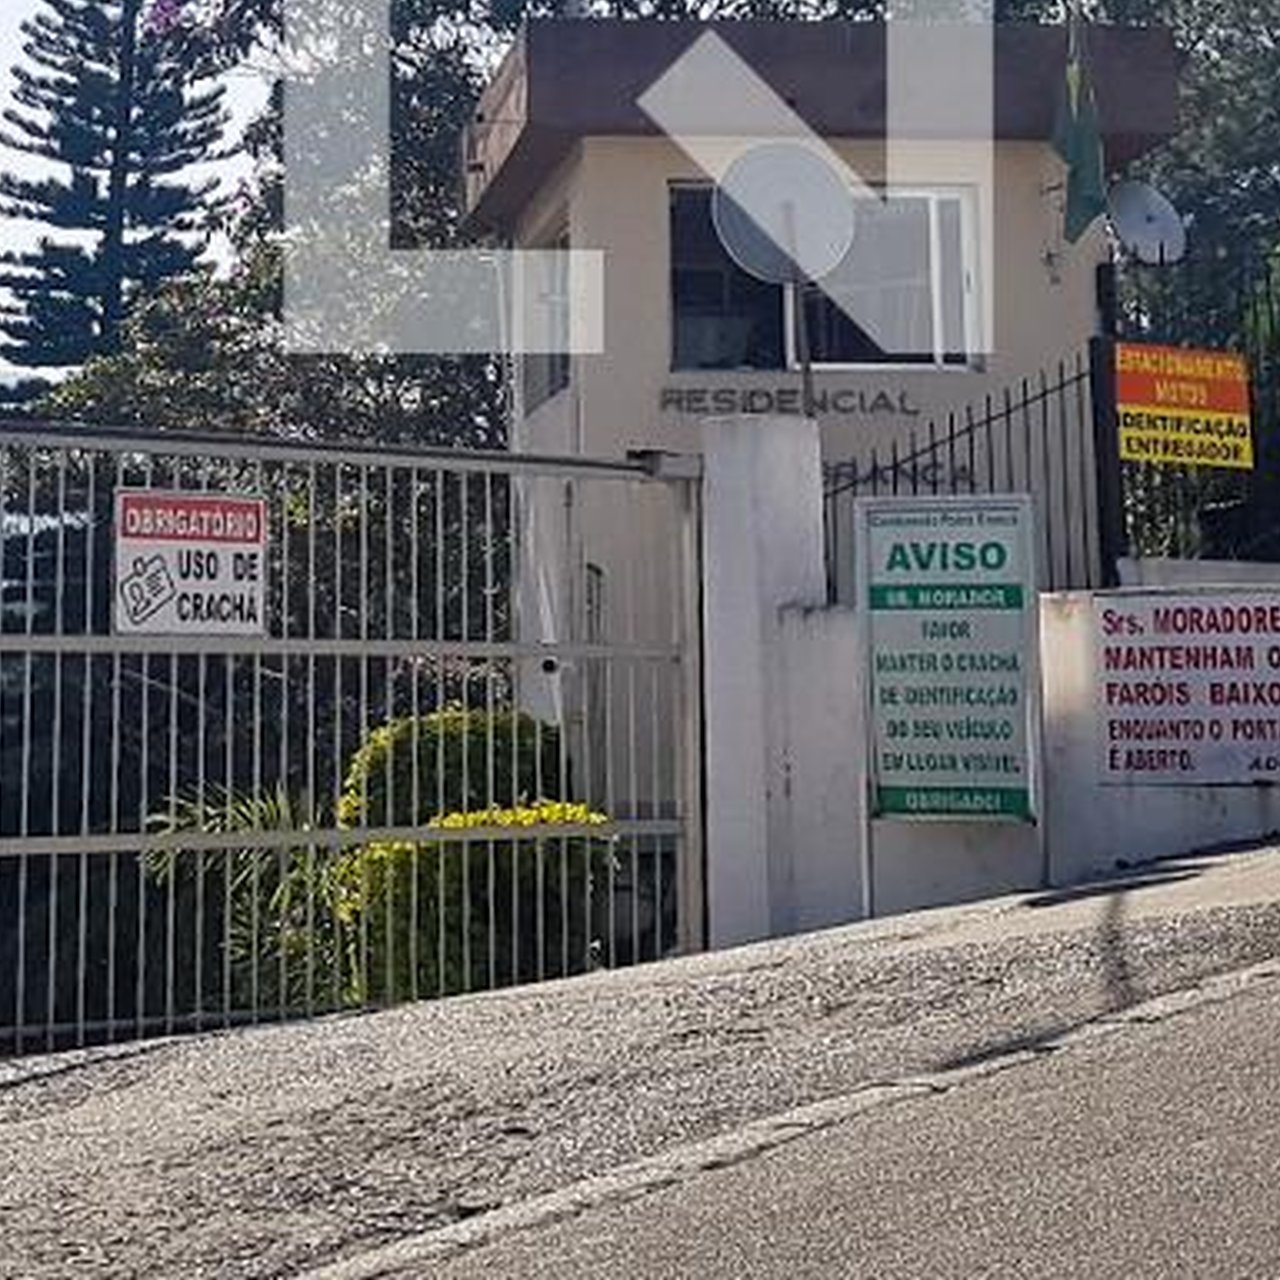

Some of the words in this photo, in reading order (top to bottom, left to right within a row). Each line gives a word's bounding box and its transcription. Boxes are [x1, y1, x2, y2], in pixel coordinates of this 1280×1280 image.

[660, 388, 919, 417] RESIDENCIAL
[126, 507, 257, 538] OBRIGATÓRIO
[178, 550, 218, 580] USO
[233, 552, 258, 581] DE
[886, 541, 1008, 570] AVISO
[177, 587, 258, 623] CRACHÁ
[919, 589, 1007, 606] MORADOR
[921, 620, 972, 639] FAVOR
[876, 652, 938, 671] MANTER
[941, 653, 953, 671] O
[1105, 646, 1255, 670] MANTENHAM
[1106, 676, 1190, 706] FARÓIS
[1109, 719, 1204, 740] ENQUANTO
[1209, 720, 1221, 739] O
[1109, 743, 1120, 770] É
